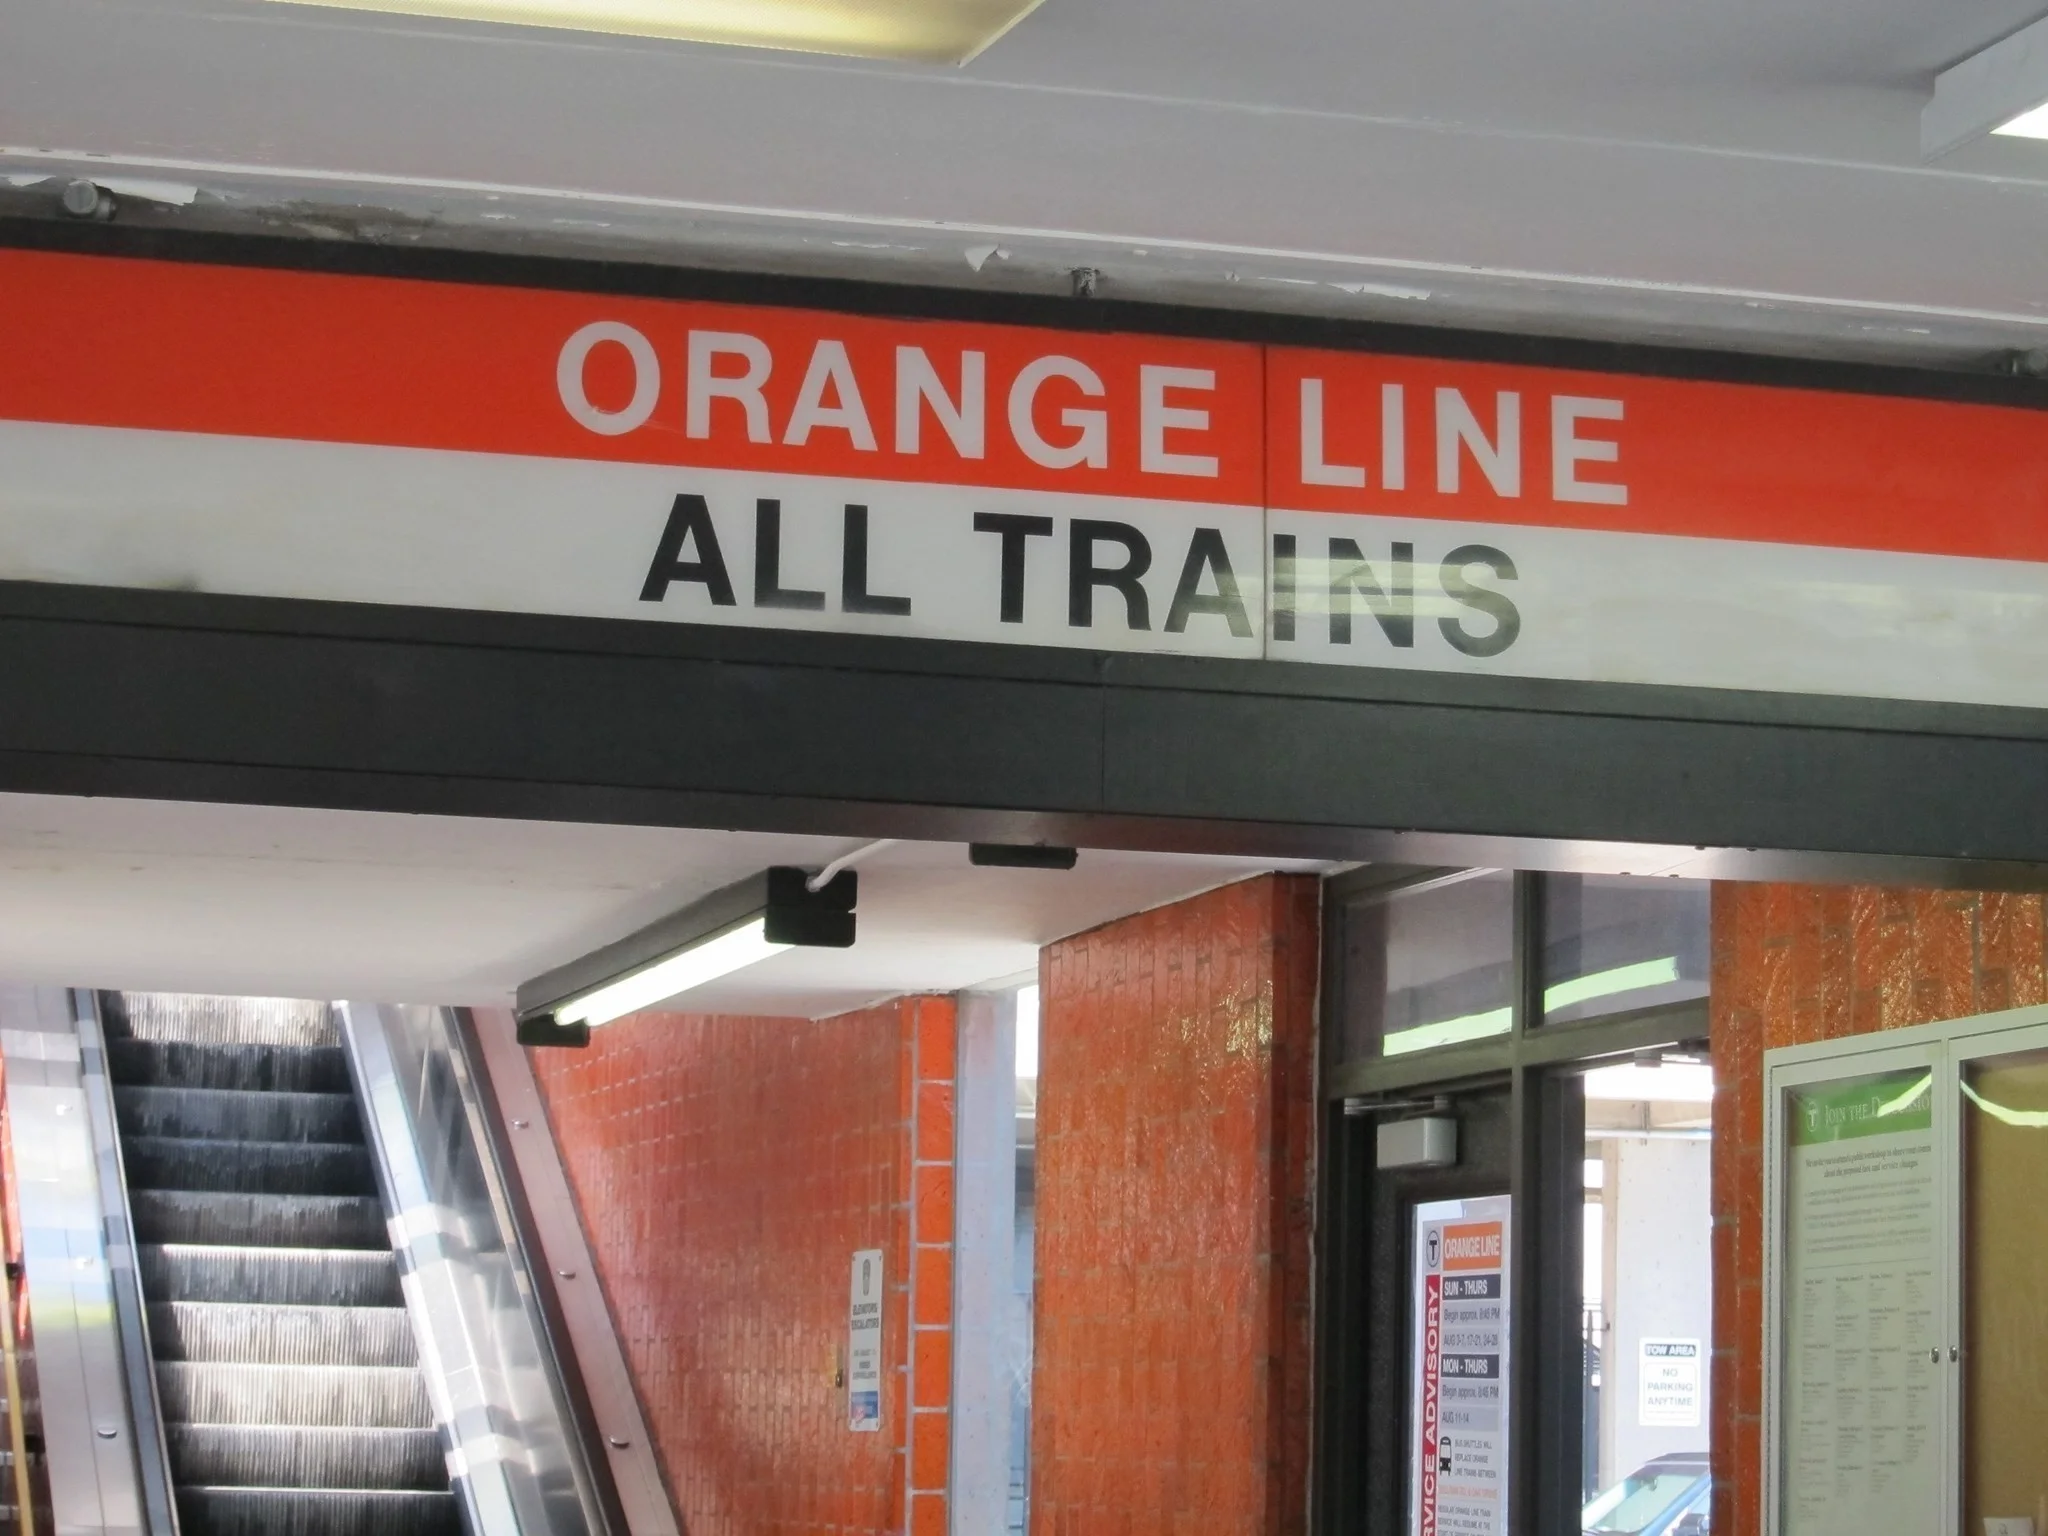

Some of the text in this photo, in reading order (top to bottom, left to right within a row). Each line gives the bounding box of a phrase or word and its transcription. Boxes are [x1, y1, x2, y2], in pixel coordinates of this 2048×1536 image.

[556, 319, 1629, 507] ORANGE LINE
[639, 492, 1522, 658] ALL TRAINS
[1444, 1234, 1500, 1259] ORANGE LINE
[1444, 1281, 1459, 1296] SUN
[1464, 1280, 1488, 1295] THURS
[1444, 1308, 1458, 1323] Begin
[1646, 1345, 1695, 1356] TOW AREA
[1425, 1285, 1439, 1445] ADVISORY
[1442, 1359, 1459, 1373] MON
[1464, 1359, 1488, 1374] THURS
[1662, 1367, 1678, 1378] NO
[1442, 1384, 1457, 1400] Begin
[1647, 1381, 1693, 1392] PARKING
[1647, 1396, 1693, 1407] ANYTIME
[1441, 1411, 1454, 1424] AUG
